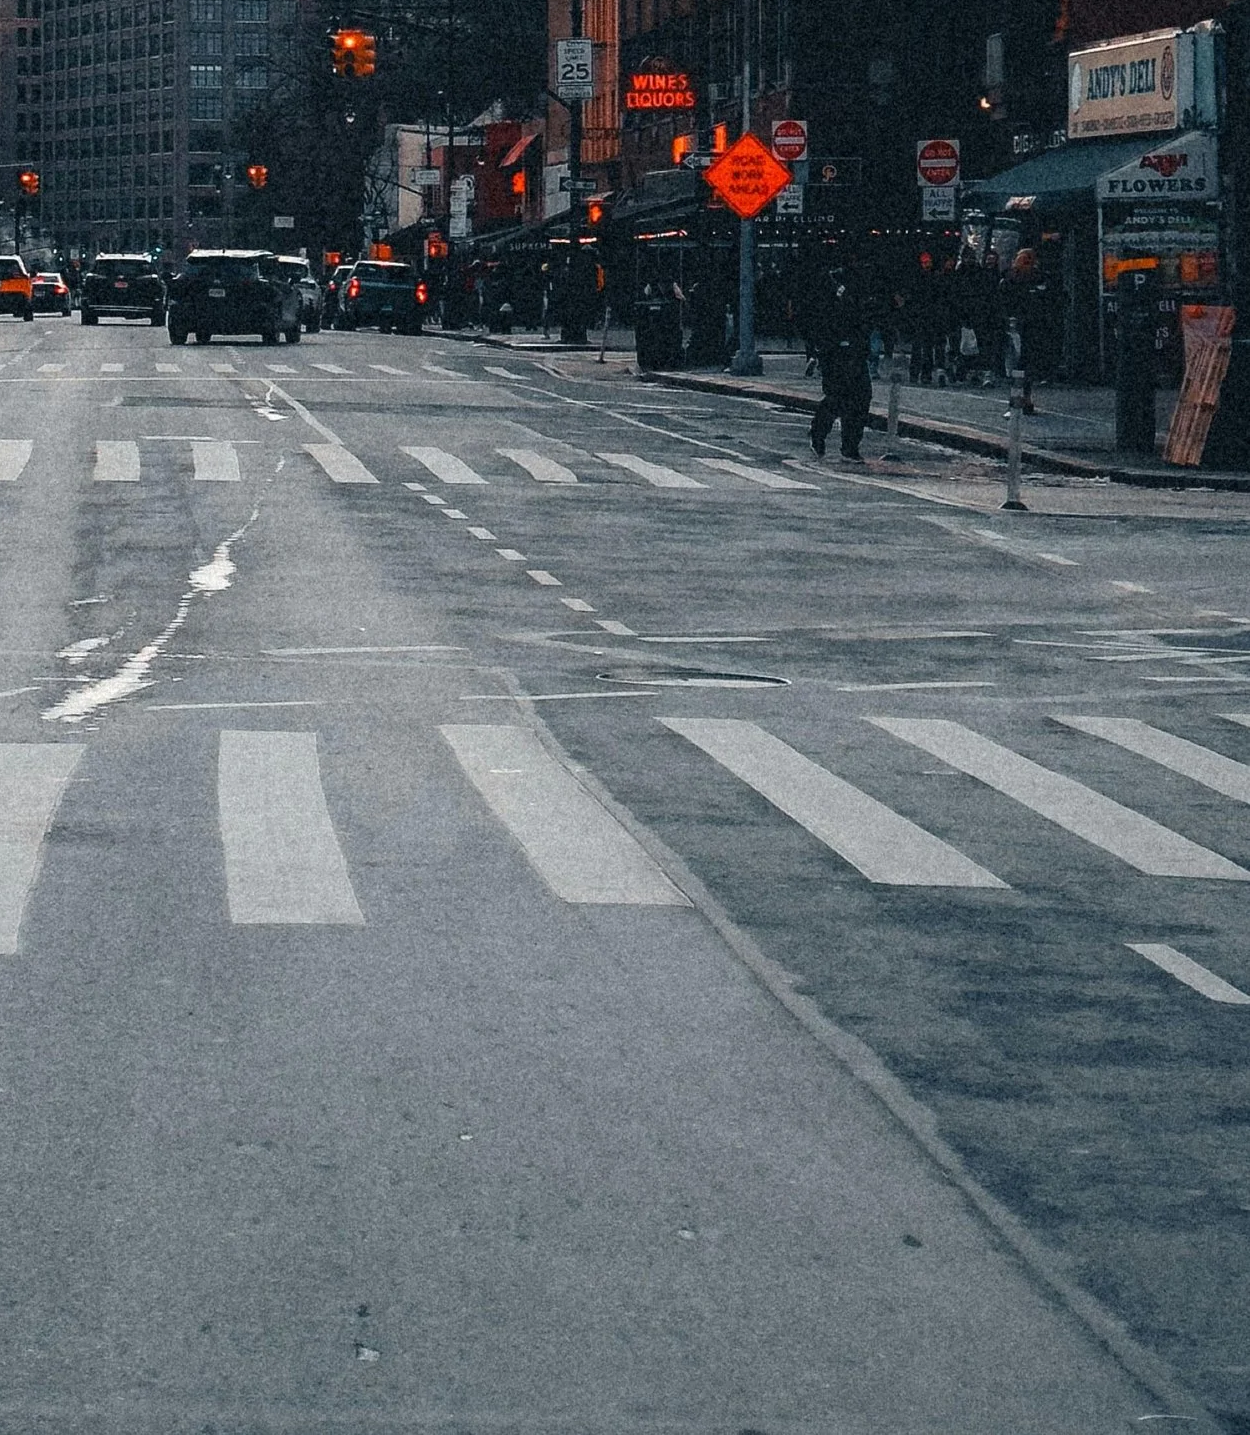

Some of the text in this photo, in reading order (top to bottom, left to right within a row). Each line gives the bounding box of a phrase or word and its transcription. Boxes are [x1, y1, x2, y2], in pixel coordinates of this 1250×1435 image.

[561, 63, 589, 80] 25
[633, 74, 688, 91] WINES
[1087, 58, 1156, 101] ANDY'S DELI
[627, 91, 696, 108] LIQUORS
[924, 148, 952, 157] DO NOT
[731, 155, 765, 166] ROAD
[732, 170, 764, 180] WORK
[926, 168, 951, 176] ENTER
[729, 184, 770, 195] AHEAD
[1108, 178, 1206, 193] FLOWERS
[929, 189, 947, 198] ALL
[924, 198, 953, 208] TRAFFIC
[753, 215, 770, 223] AR
[1124, 215, 1192, 225] ANDY'S DELI
